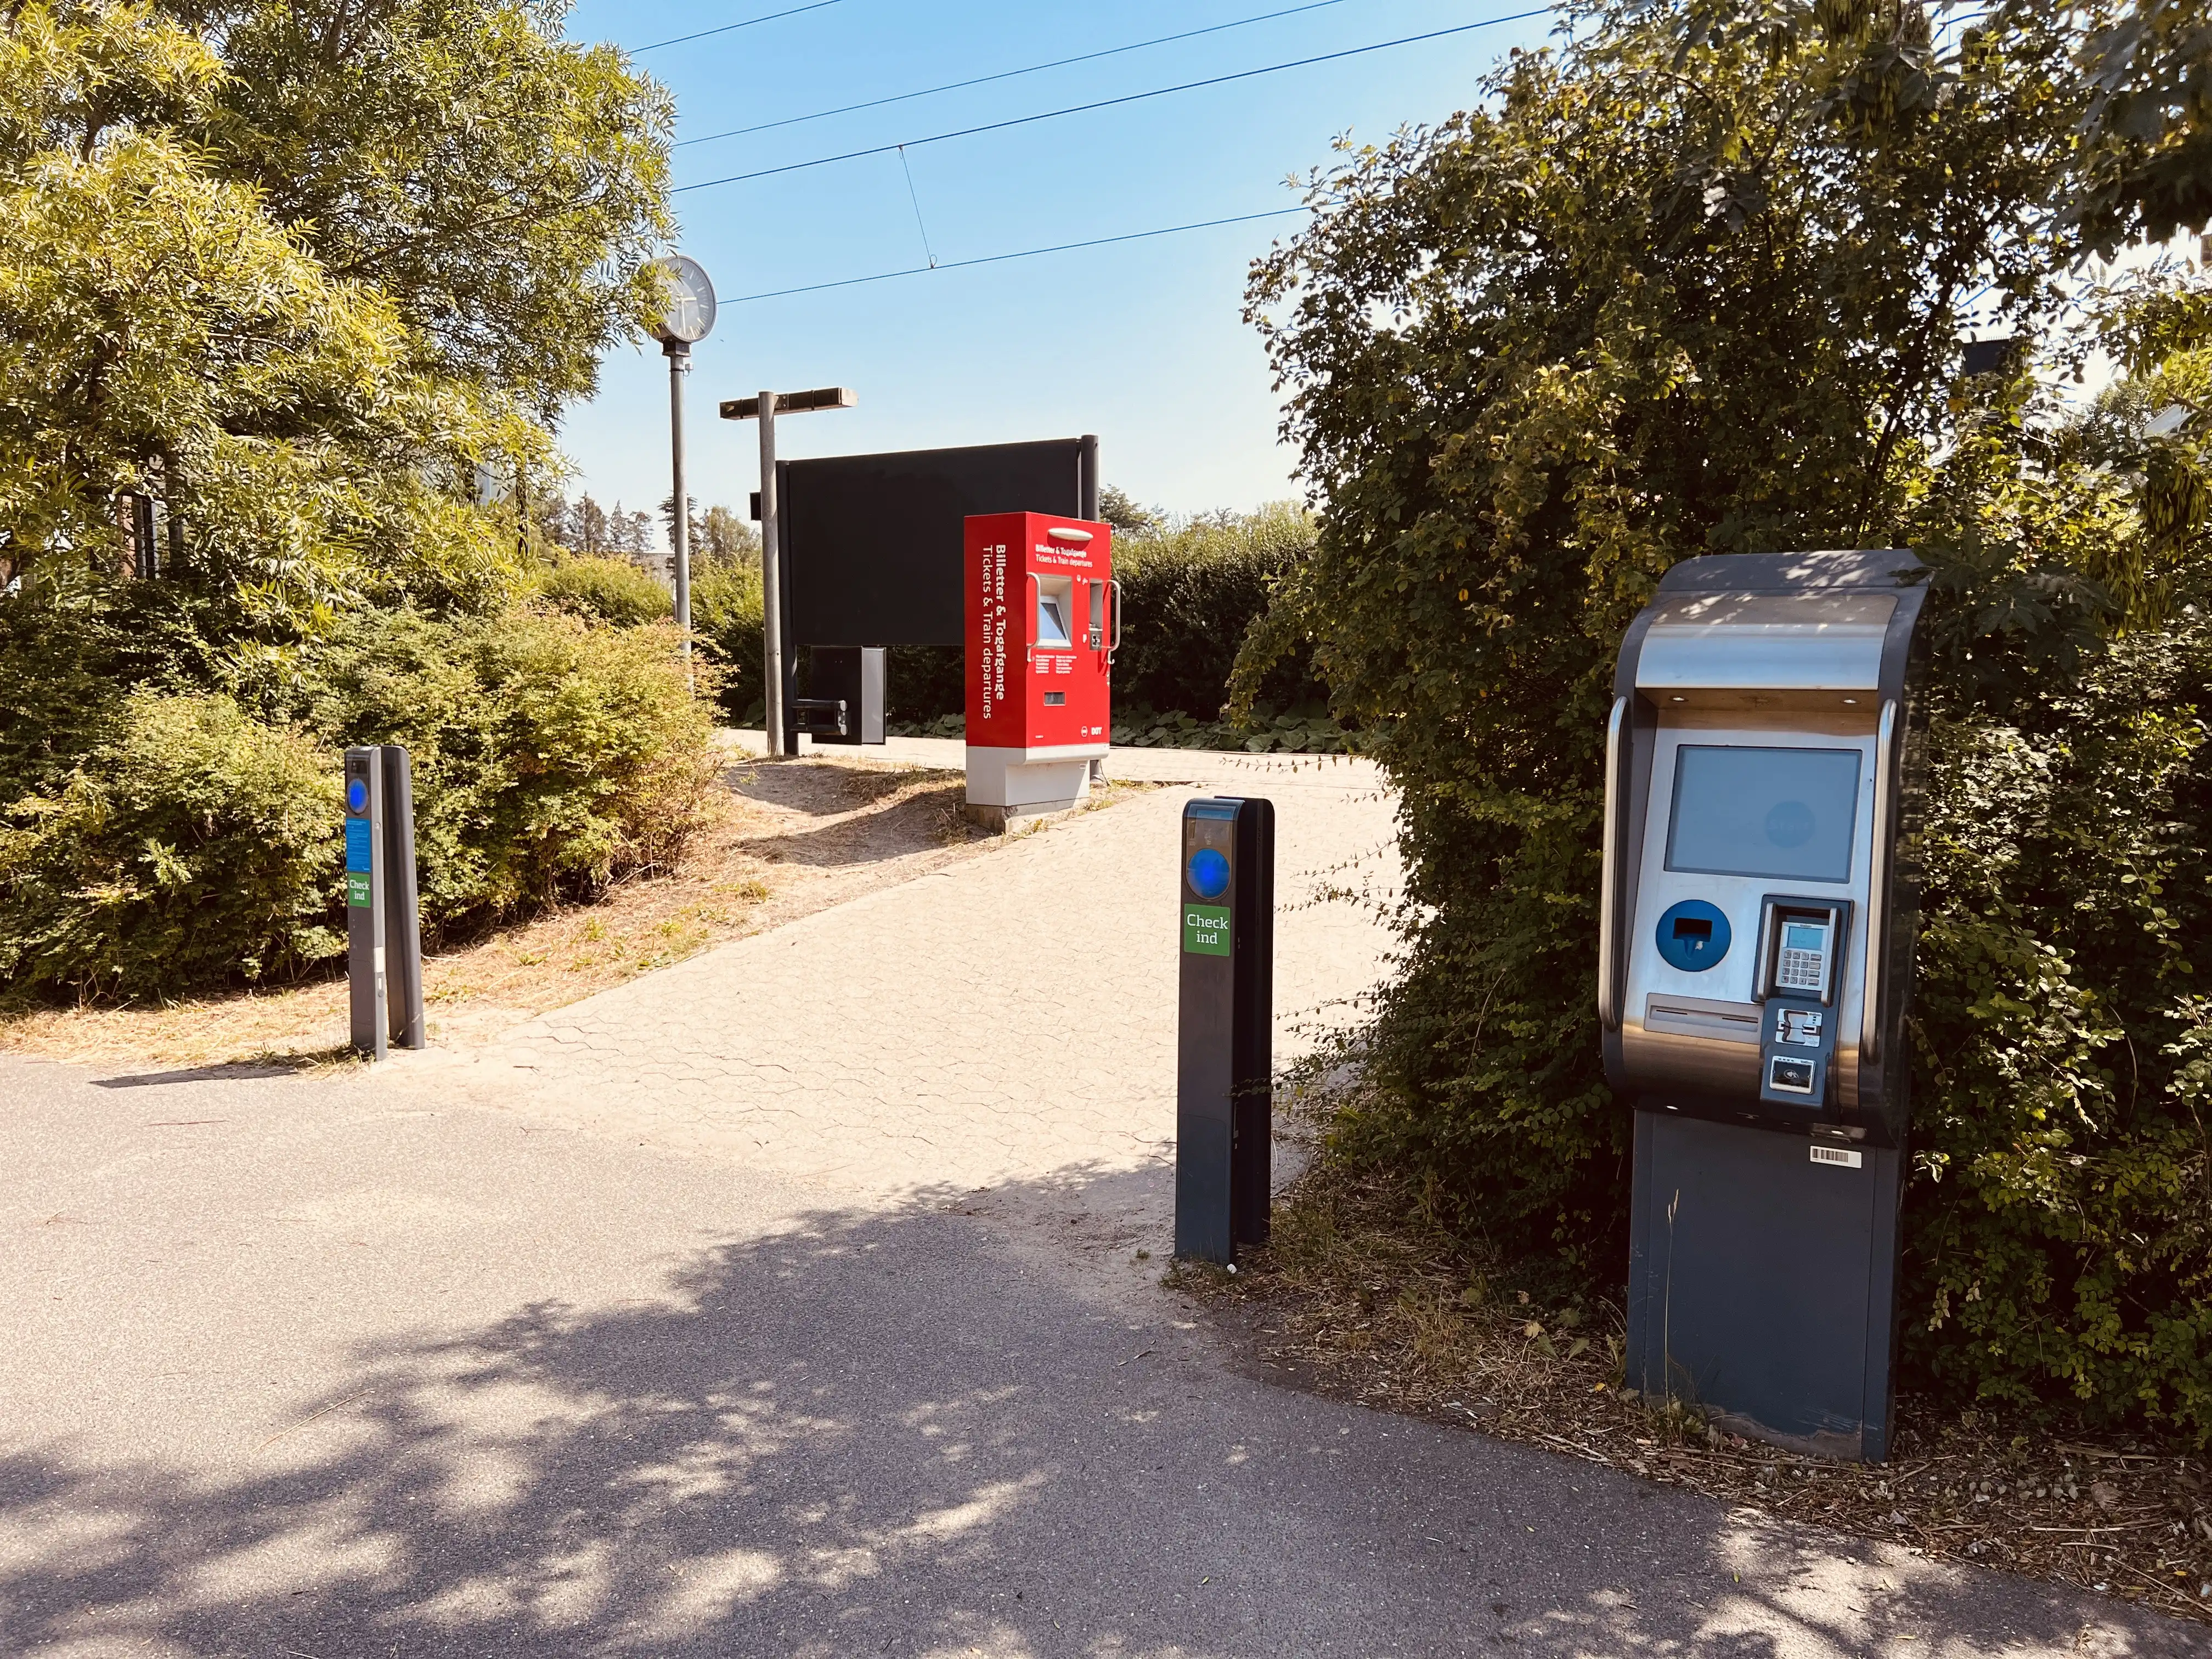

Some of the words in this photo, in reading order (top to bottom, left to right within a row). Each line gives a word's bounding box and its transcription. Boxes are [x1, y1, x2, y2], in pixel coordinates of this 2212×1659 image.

[1035, 544, 1054, 554] Billetter
[1056, 546, 1060, 555] &
[1060, 547, 1087, 559] Togafgange
[1036, 554, 1052, 564] Tickets
[1053, 556, 1057, 564] &
[1058, 556, 1069, 565] Train
[1069, 558, 1093, 568] departures
[983, 545, 993, 593] Tickets
[996, 544, 1006, 602] Billetter
[983, 597, 993, 607] &
[996, 605, 1006, 616] &
[983, 611, 993, 644] Train
[995, 619, 1006, 700] Togafgange
[981, 648, 994, 719] departures
[1091, 726, 1102, 735] DOT
[349, 879, 370, 890] Check
[354, 891, 365, 900] ind
[1187, 913, 1228, 929] Check
[1196, 930, 1218, 944] ind
